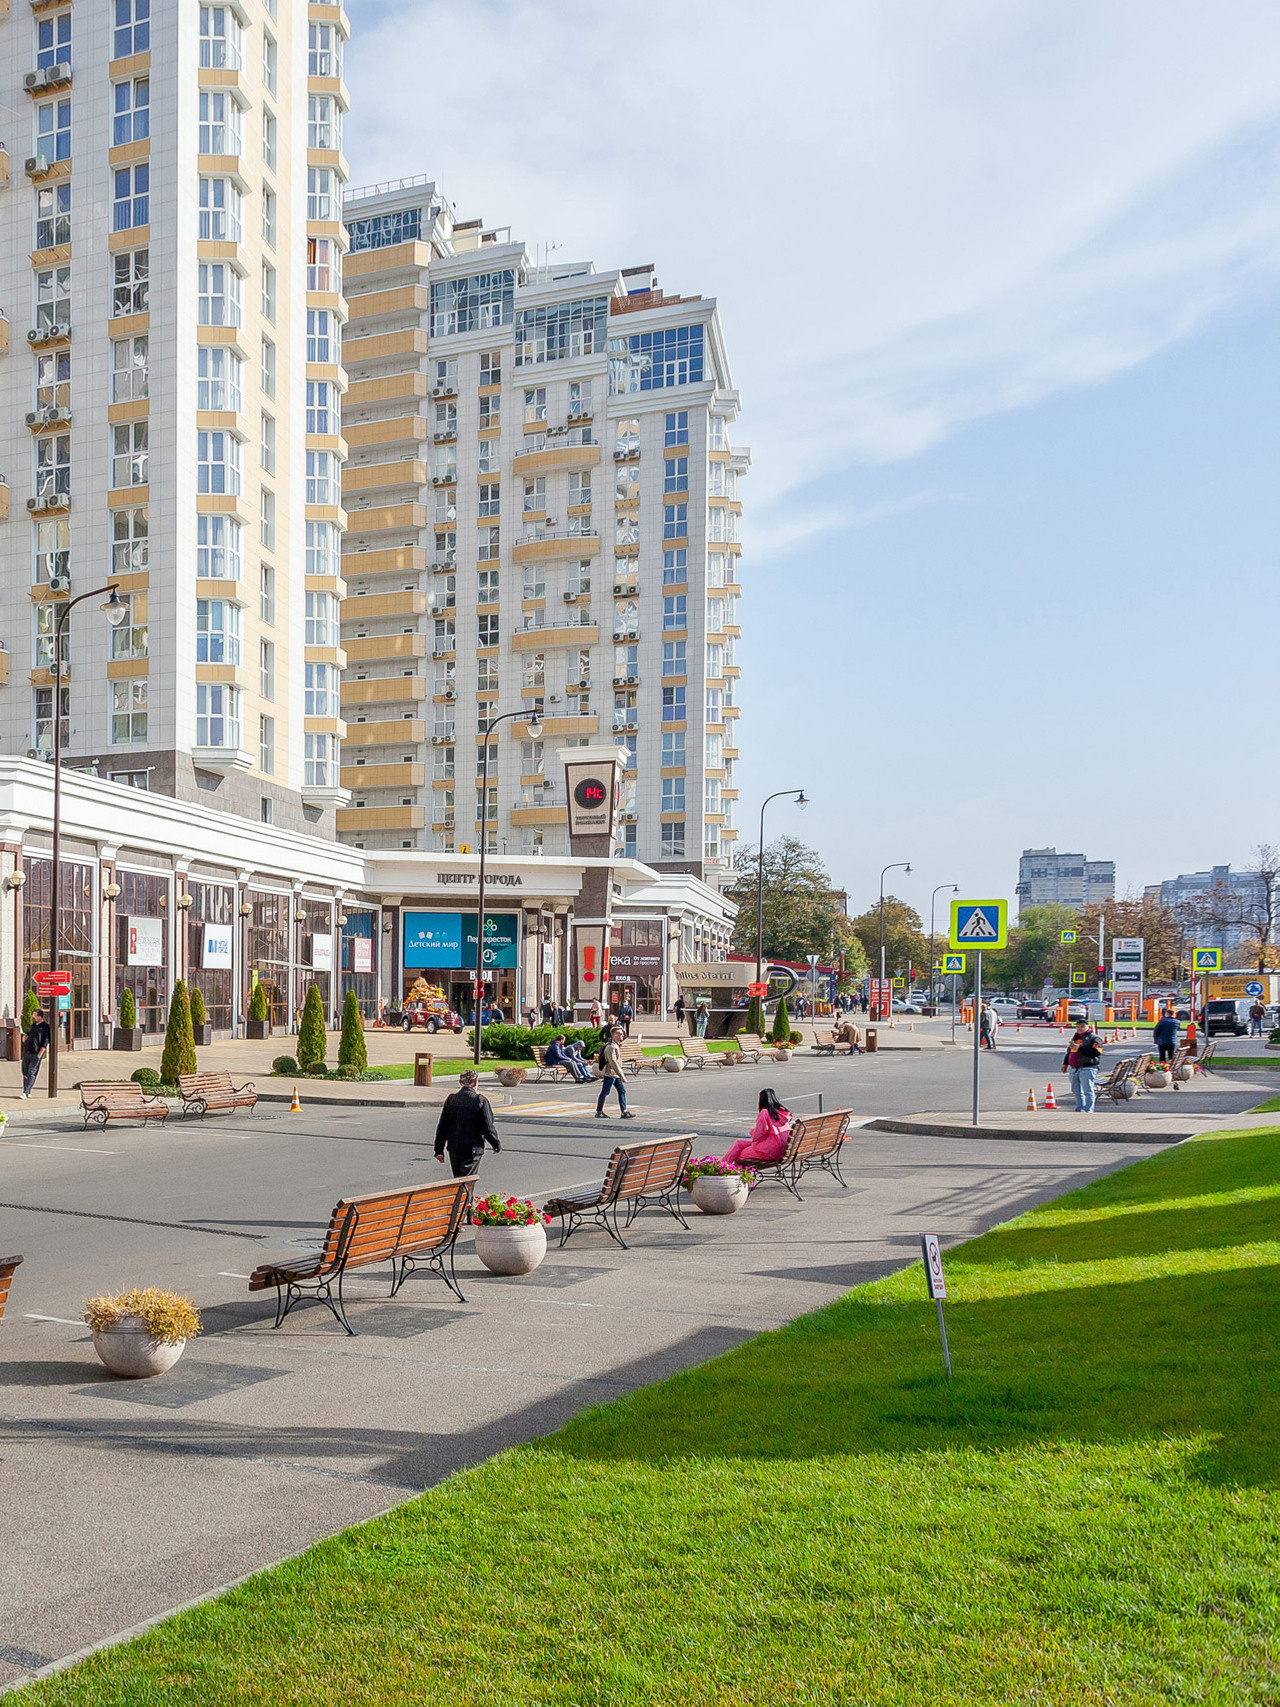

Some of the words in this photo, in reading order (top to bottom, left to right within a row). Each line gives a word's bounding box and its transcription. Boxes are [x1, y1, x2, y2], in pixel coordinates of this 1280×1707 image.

[437, 873, 476, 886] ЦЕНТР
[467, 935, 512, 944] Перкресток
[408, 940, 440, 948] Детский
[442, 942, 458, 950] мир
[610, 956, 631, 966] ека
[470, 971, 493, 982] ВОД
